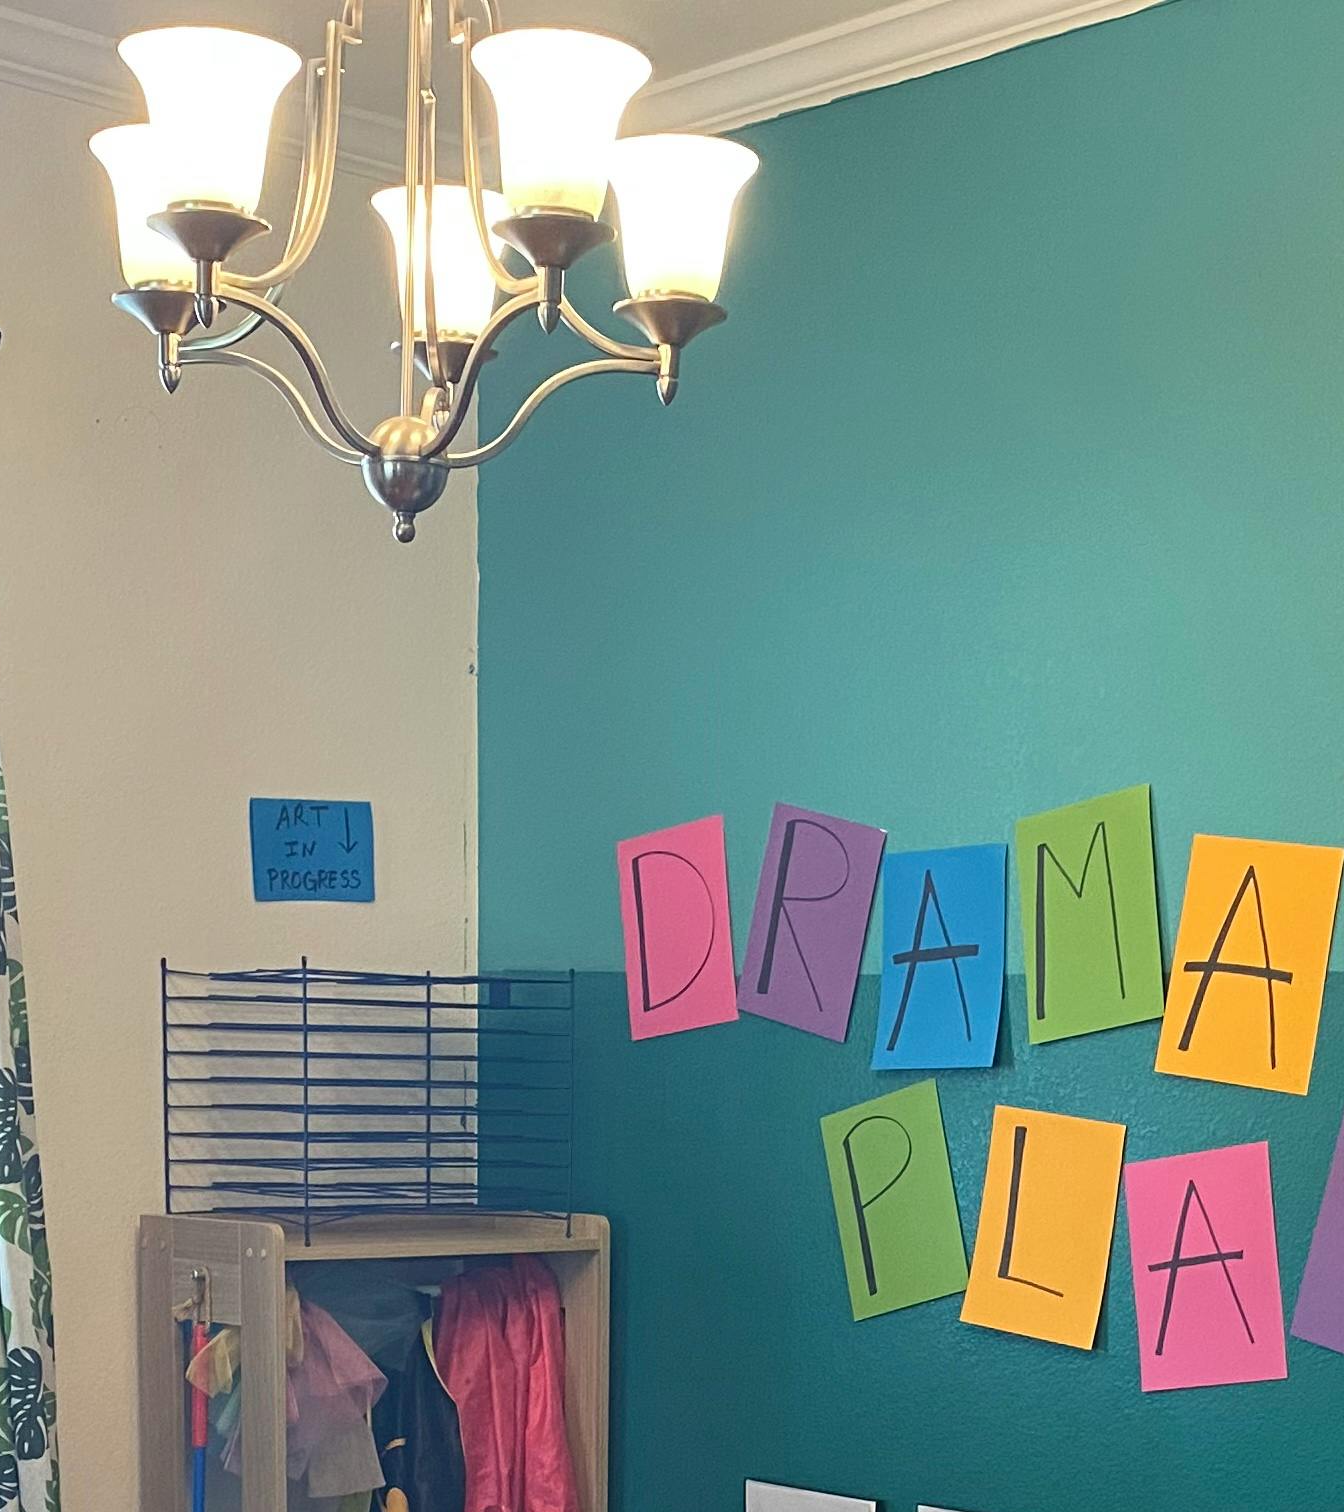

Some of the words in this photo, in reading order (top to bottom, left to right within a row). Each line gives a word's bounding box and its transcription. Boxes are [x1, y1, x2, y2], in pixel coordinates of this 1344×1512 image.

[276, 803, 329, 831] ART
[284, 840, 316, 858] IN
[267, 868, 362, 892] PROGRESS
